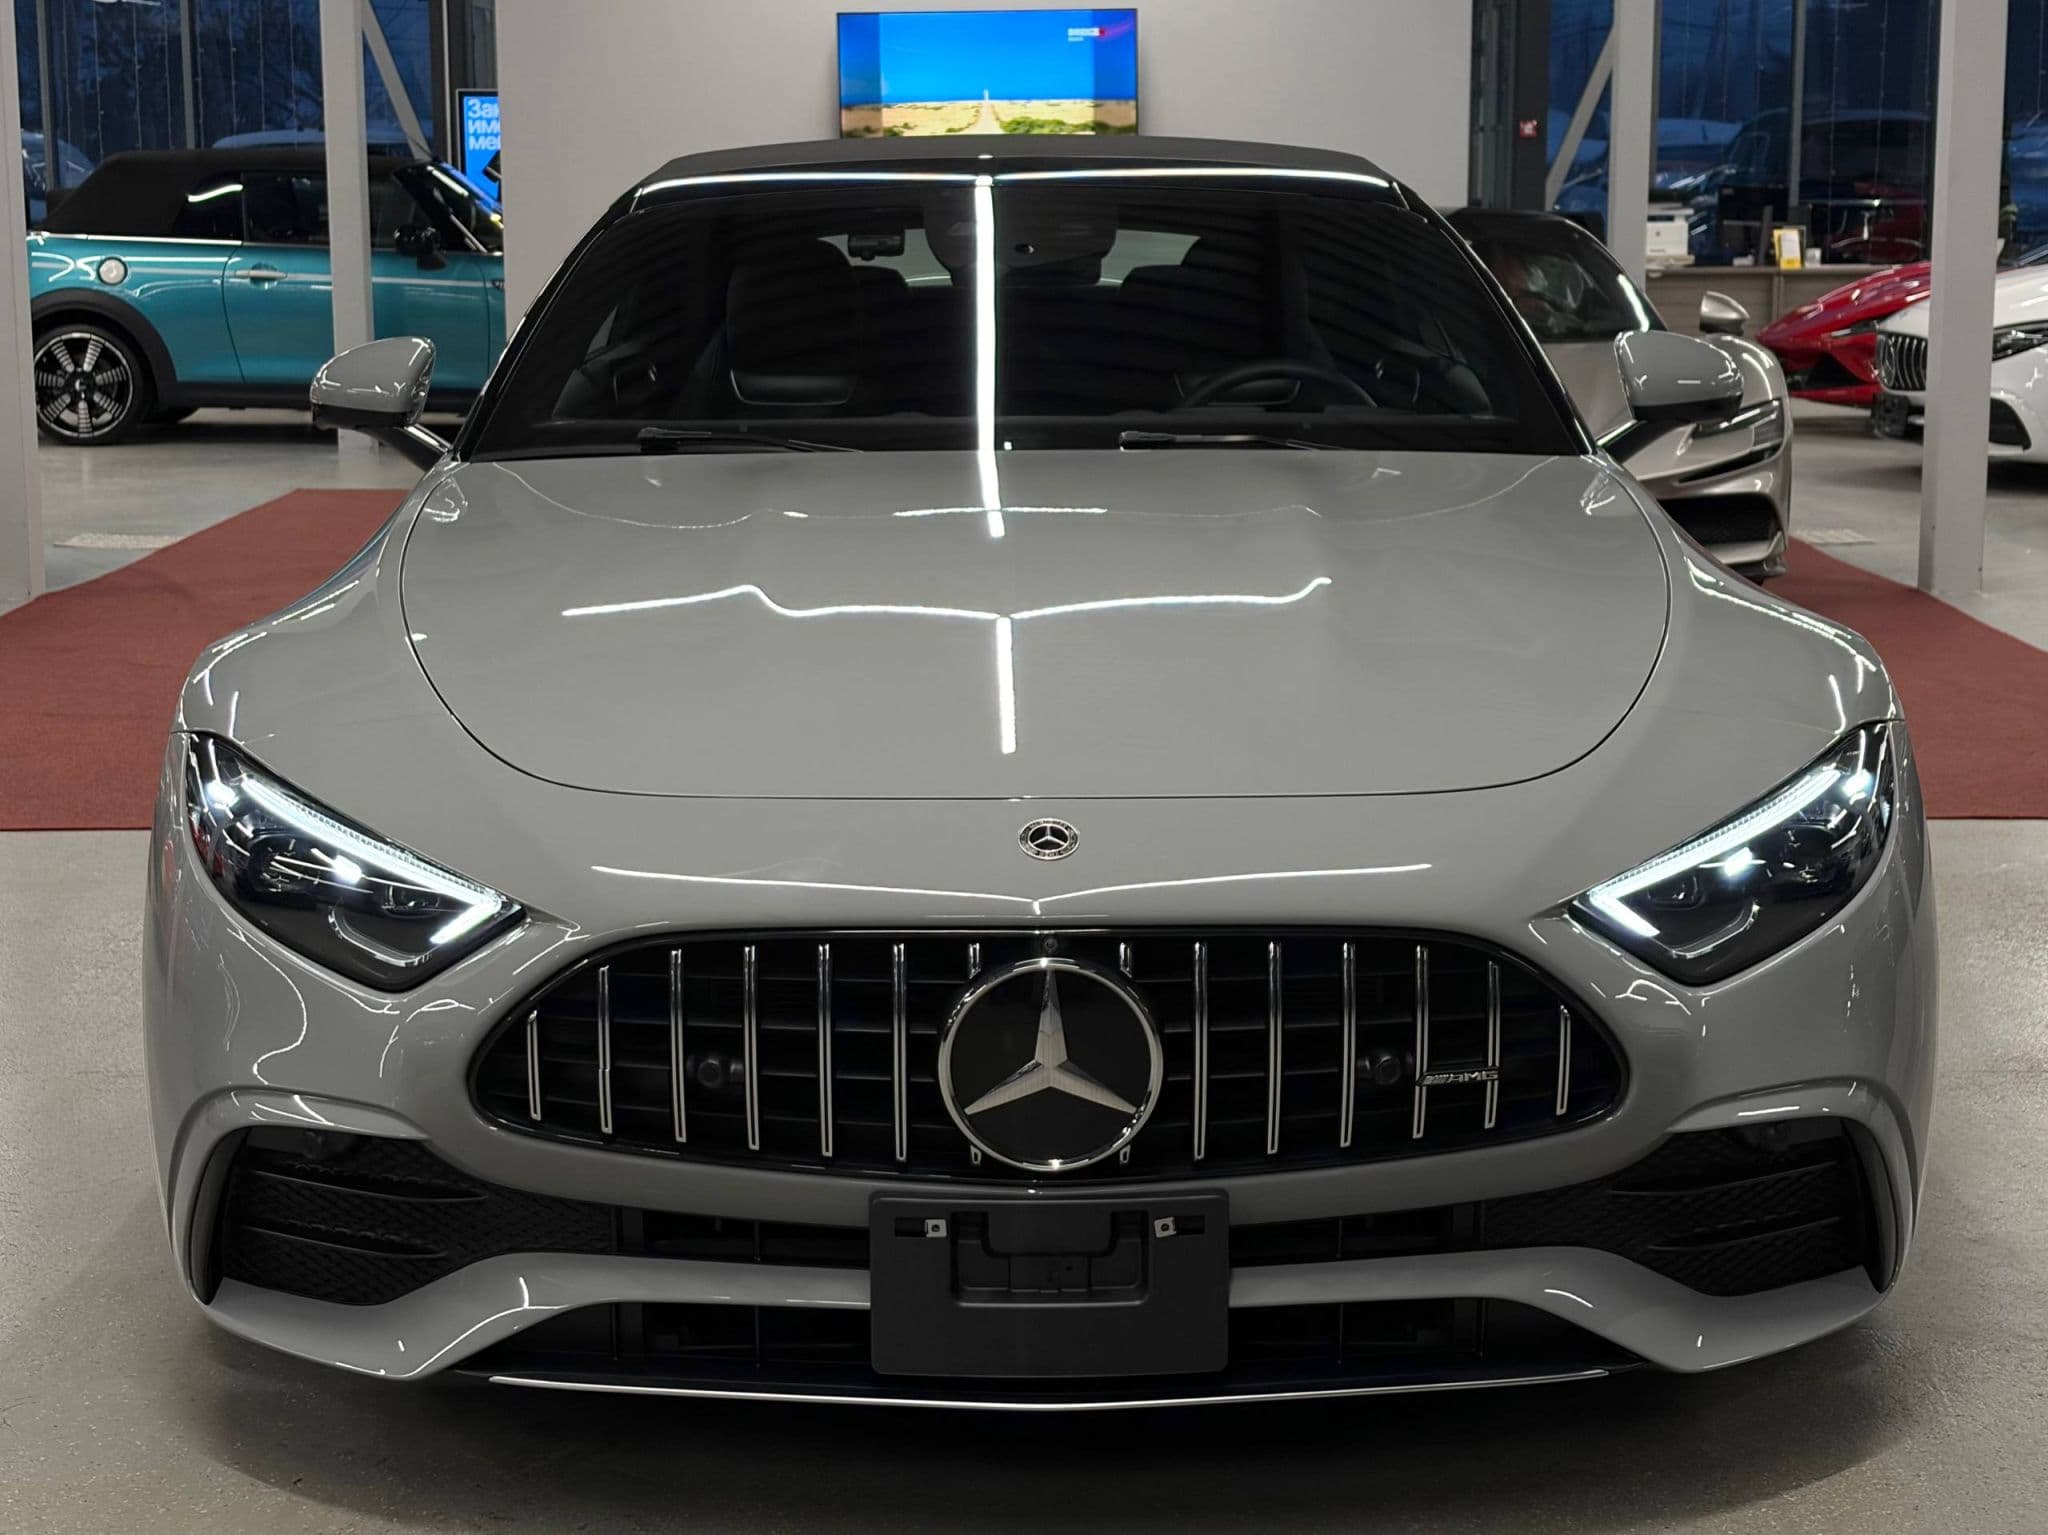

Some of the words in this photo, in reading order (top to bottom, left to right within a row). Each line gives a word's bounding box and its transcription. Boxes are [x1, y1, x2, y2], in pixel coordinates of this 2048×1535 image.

[468, 119, 500, 134] им
[469, 135, 501, 150] ме
[1445, 1070, 1499, 1084] AMG
